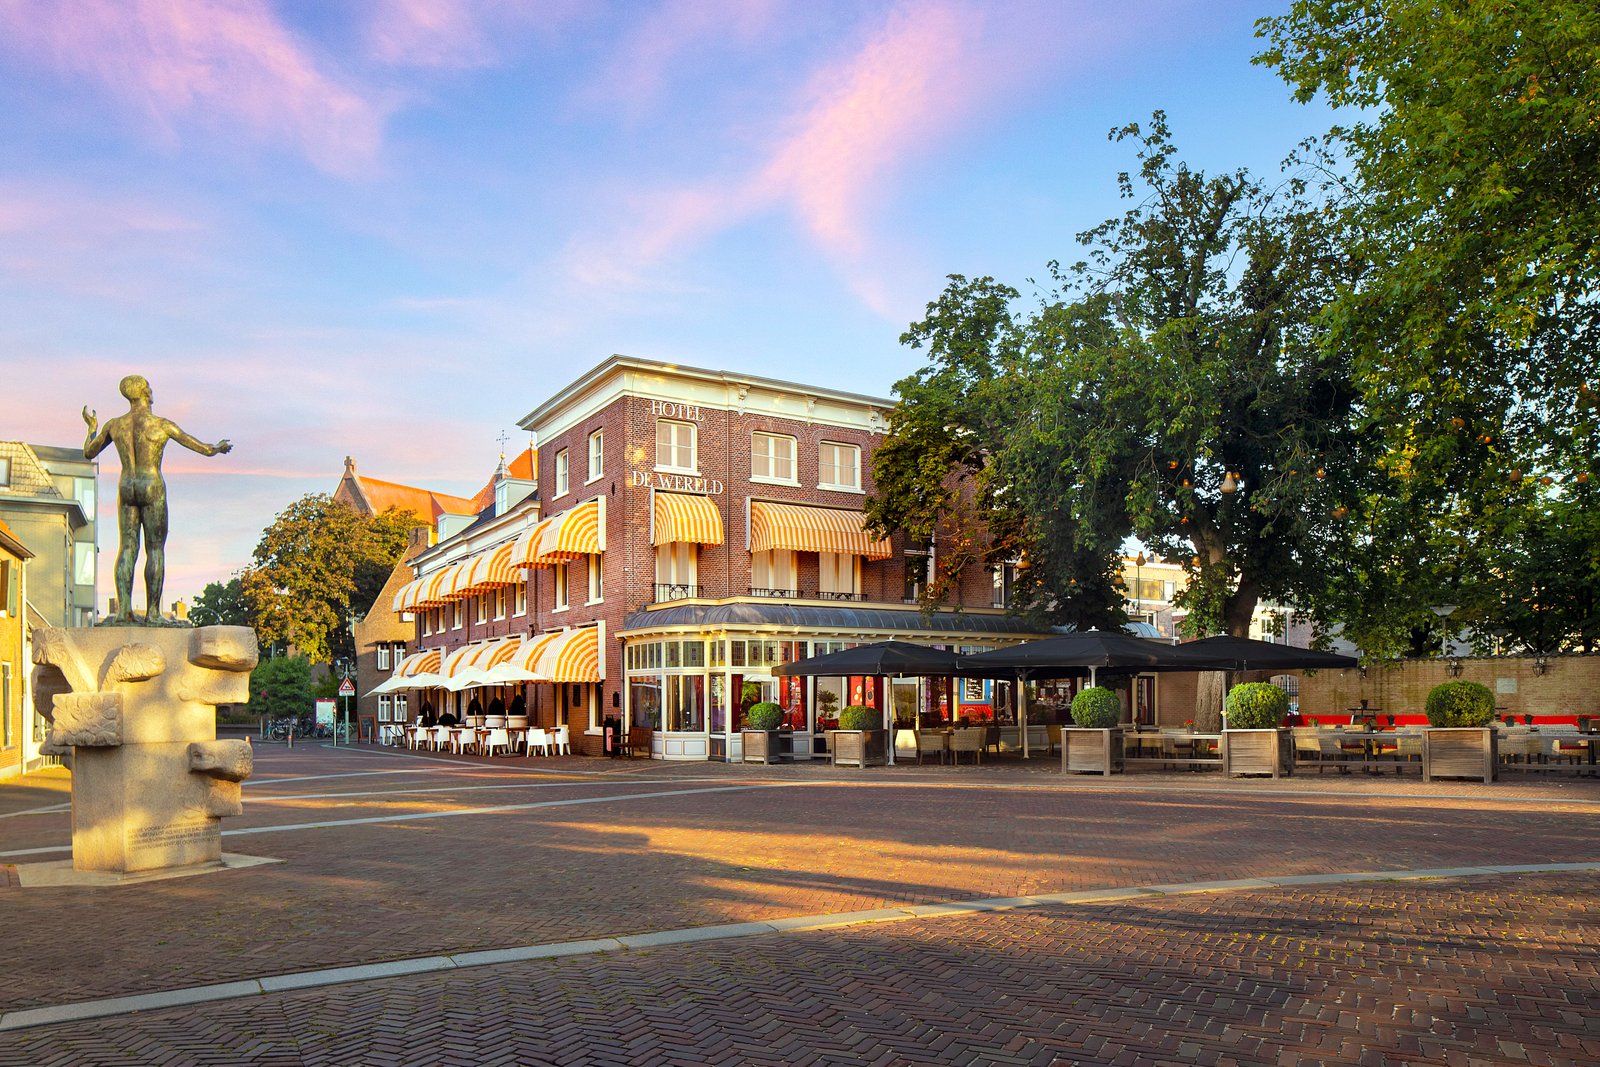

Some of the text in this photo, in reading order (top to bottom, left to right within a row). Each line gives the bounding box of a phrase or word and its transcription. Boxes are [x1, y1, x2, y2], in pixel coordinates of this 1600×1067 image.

[651, 400, 704, 422] HOTEL
[632, 470, 724, 495] DE WERELD
